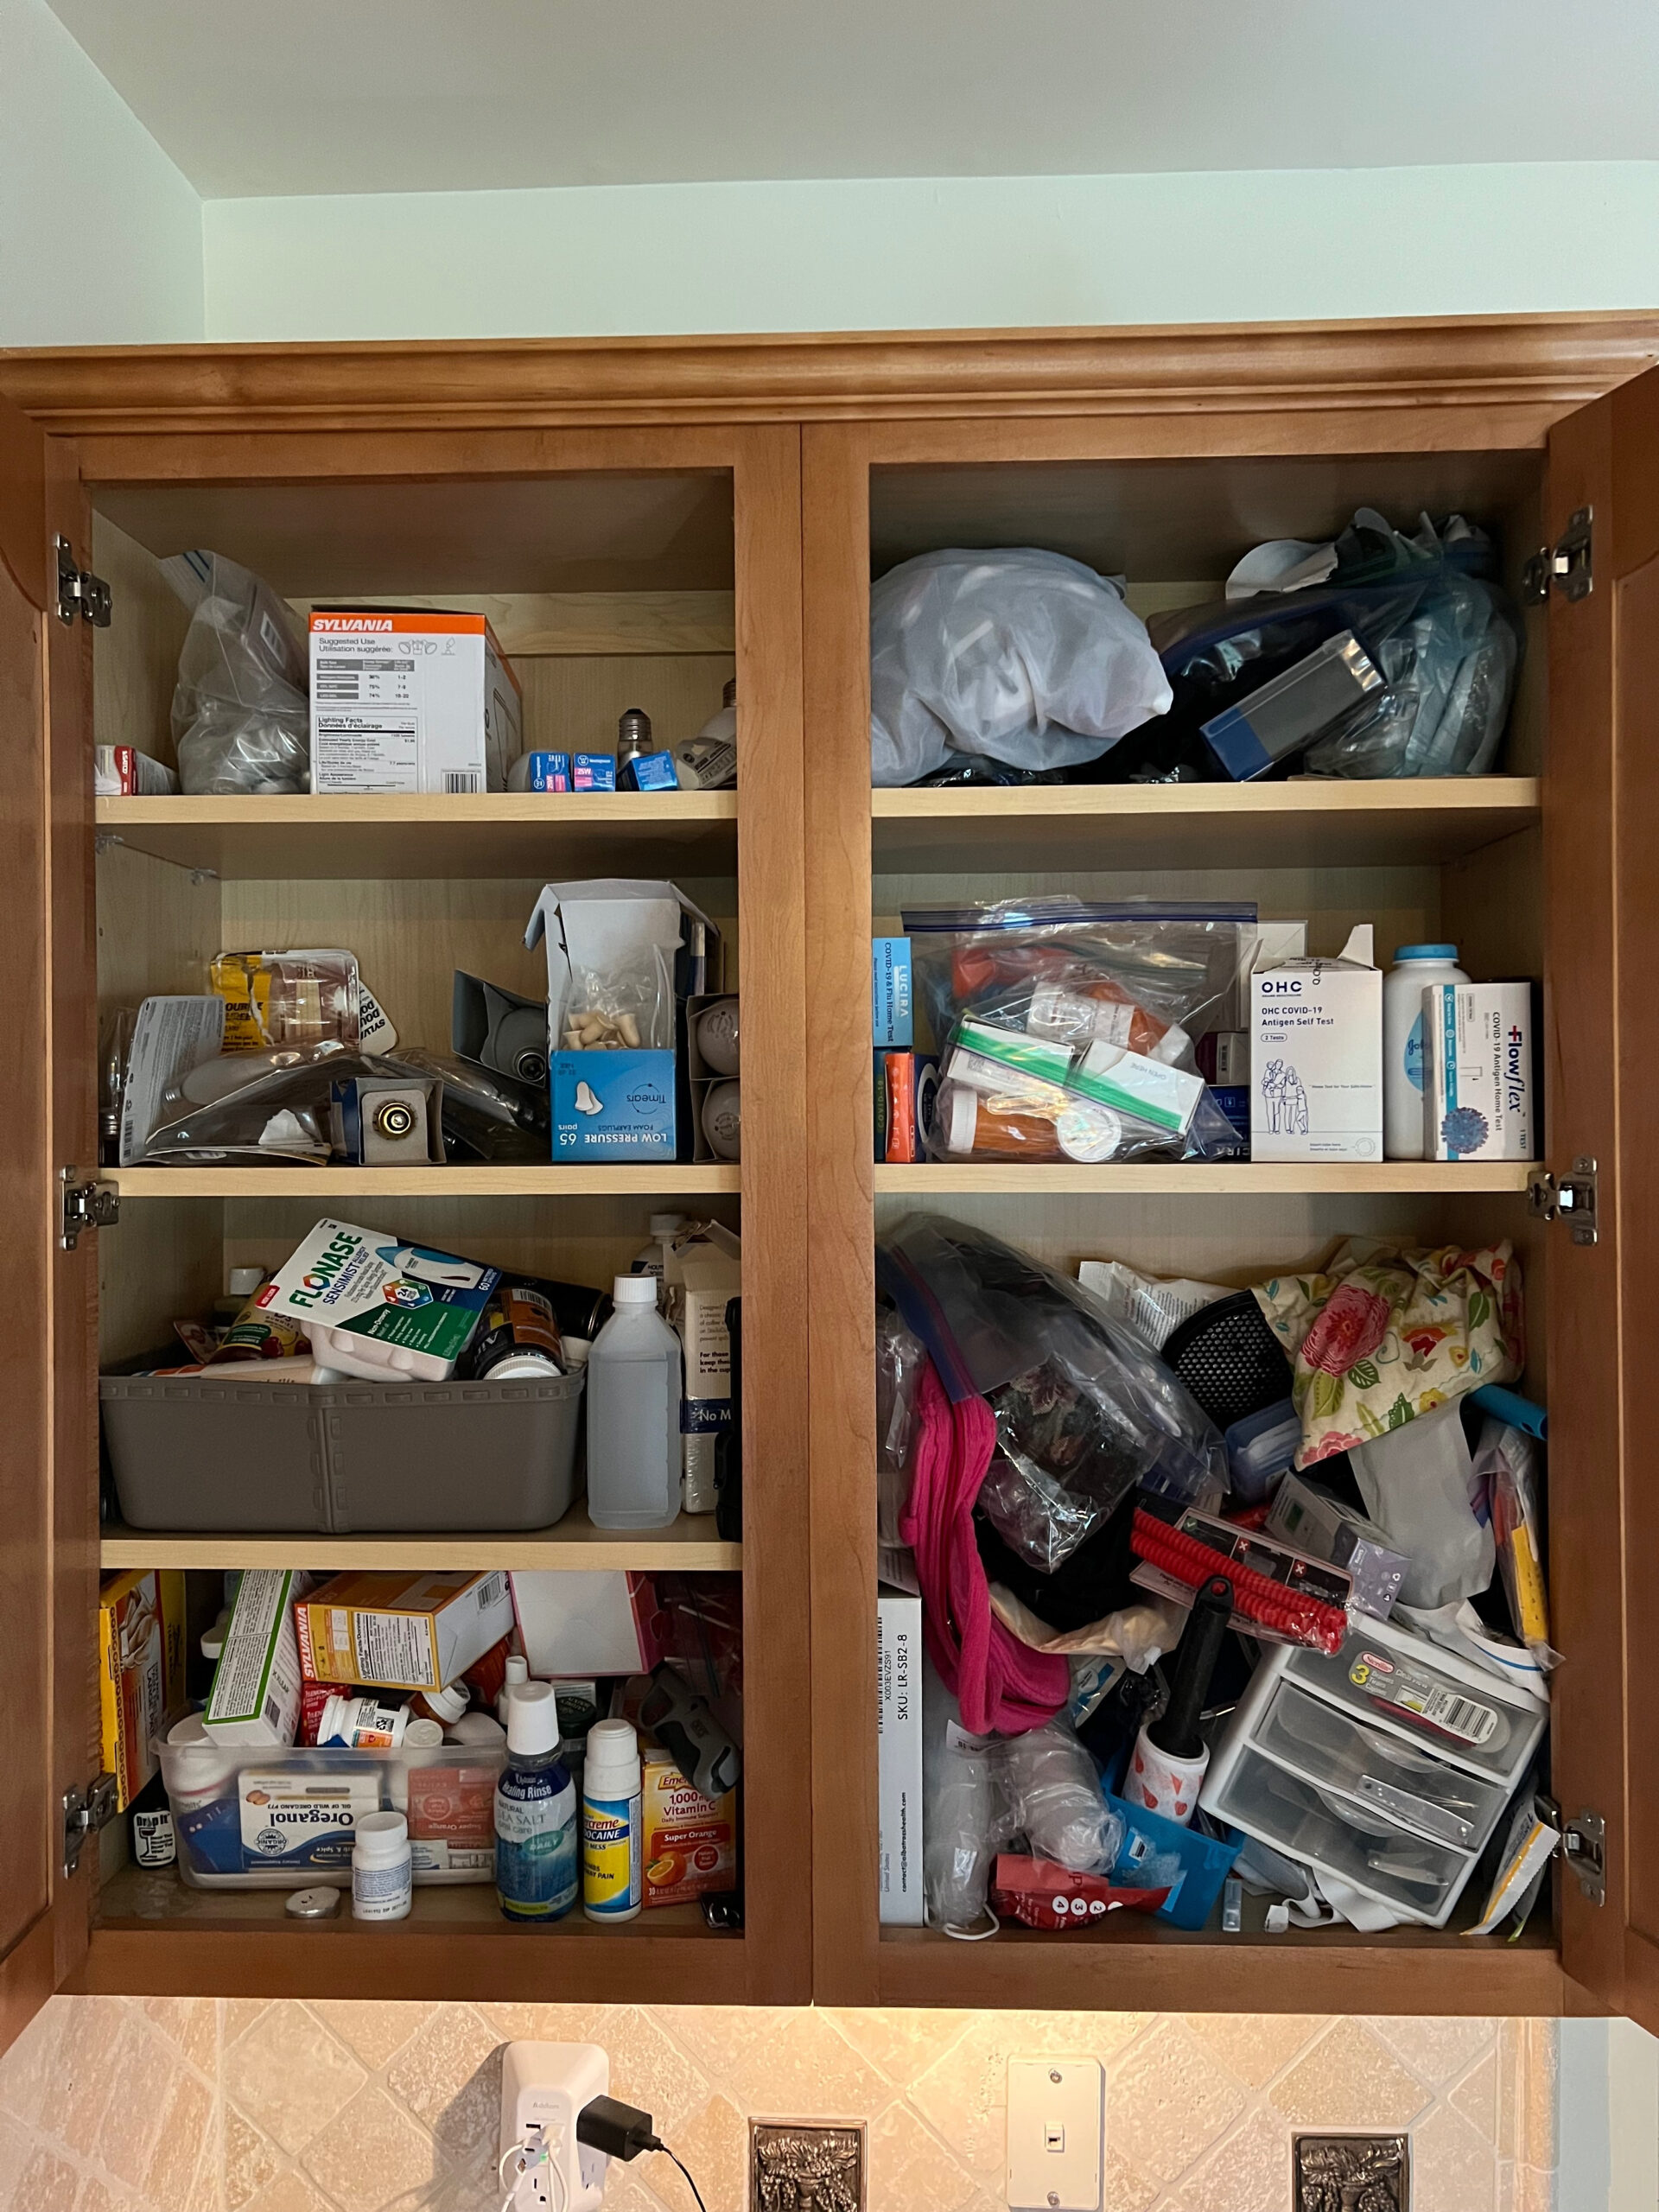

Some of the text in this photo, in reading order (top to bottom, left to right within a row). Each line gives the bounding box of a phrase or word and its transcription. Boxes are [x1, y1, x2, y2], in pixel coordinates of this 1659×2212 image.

[313, 620, 393, 632] SYLVANIA
[319, 638, 358, 646] Suggested
[1262, 981, 1302, 993] OHC
[1262, 1006, 1323, 1015] OHC COVID-19
[1262, 1017, 1334, 1027] Antigen Self Test
[1492, 1012, 1501, 1052] COVID-19
[1492, 1054, 1502, 1087] Antigen
[1503, 1026, 1526, 1113] Flowflex
[626, 1094, 666, 1104] Timears
[559, 1133, 577, 1146] 65
[584, 1133, 667, 1143] LOW PRESSURE
[352, 1246, 366, 1262] ALLERGY
[356, 1251, 370, 1265] RELIEF
[289, 1232, 363, 1308] FLONASE
[322, 1262, 361, 1305] SENSIMIST
[479, 1282, 490, 1291] 60
[397, 1287, 409, 1296] 24
[367, 1308, 391, 1335] Non-Drowsy
[699, 1408, 732, 1421] No M
[297, 1606, 315, 1679] SYLVANIA
[359, 1656, 367, 1679] Lighting
[1351, 1663, 1370, 1685] 3
[897, 1634, 908, 1720] SKU: LR-SB2-8
[501, 1781, 553, 1801] Healing Rinse
[670, 1791, 698, 1806] 1,000
[498, 1800, 524, 1815] NATURAL
[664, 1801, 716, 1816] Vitamin C
[270, 1809, 354, 1827] Oreganol
[517, 1814, 547, 1826] SALT
[698, 1811, 720, 1820] Support
[429, 1822, 458, 1831] Orange
[512, 1825, 533, 1835] care
[664, 1830, 718, 1843] Super Orange
[648, 1887, 656, 1896] 30
[1057, 1900, 1065, 1909] 4
